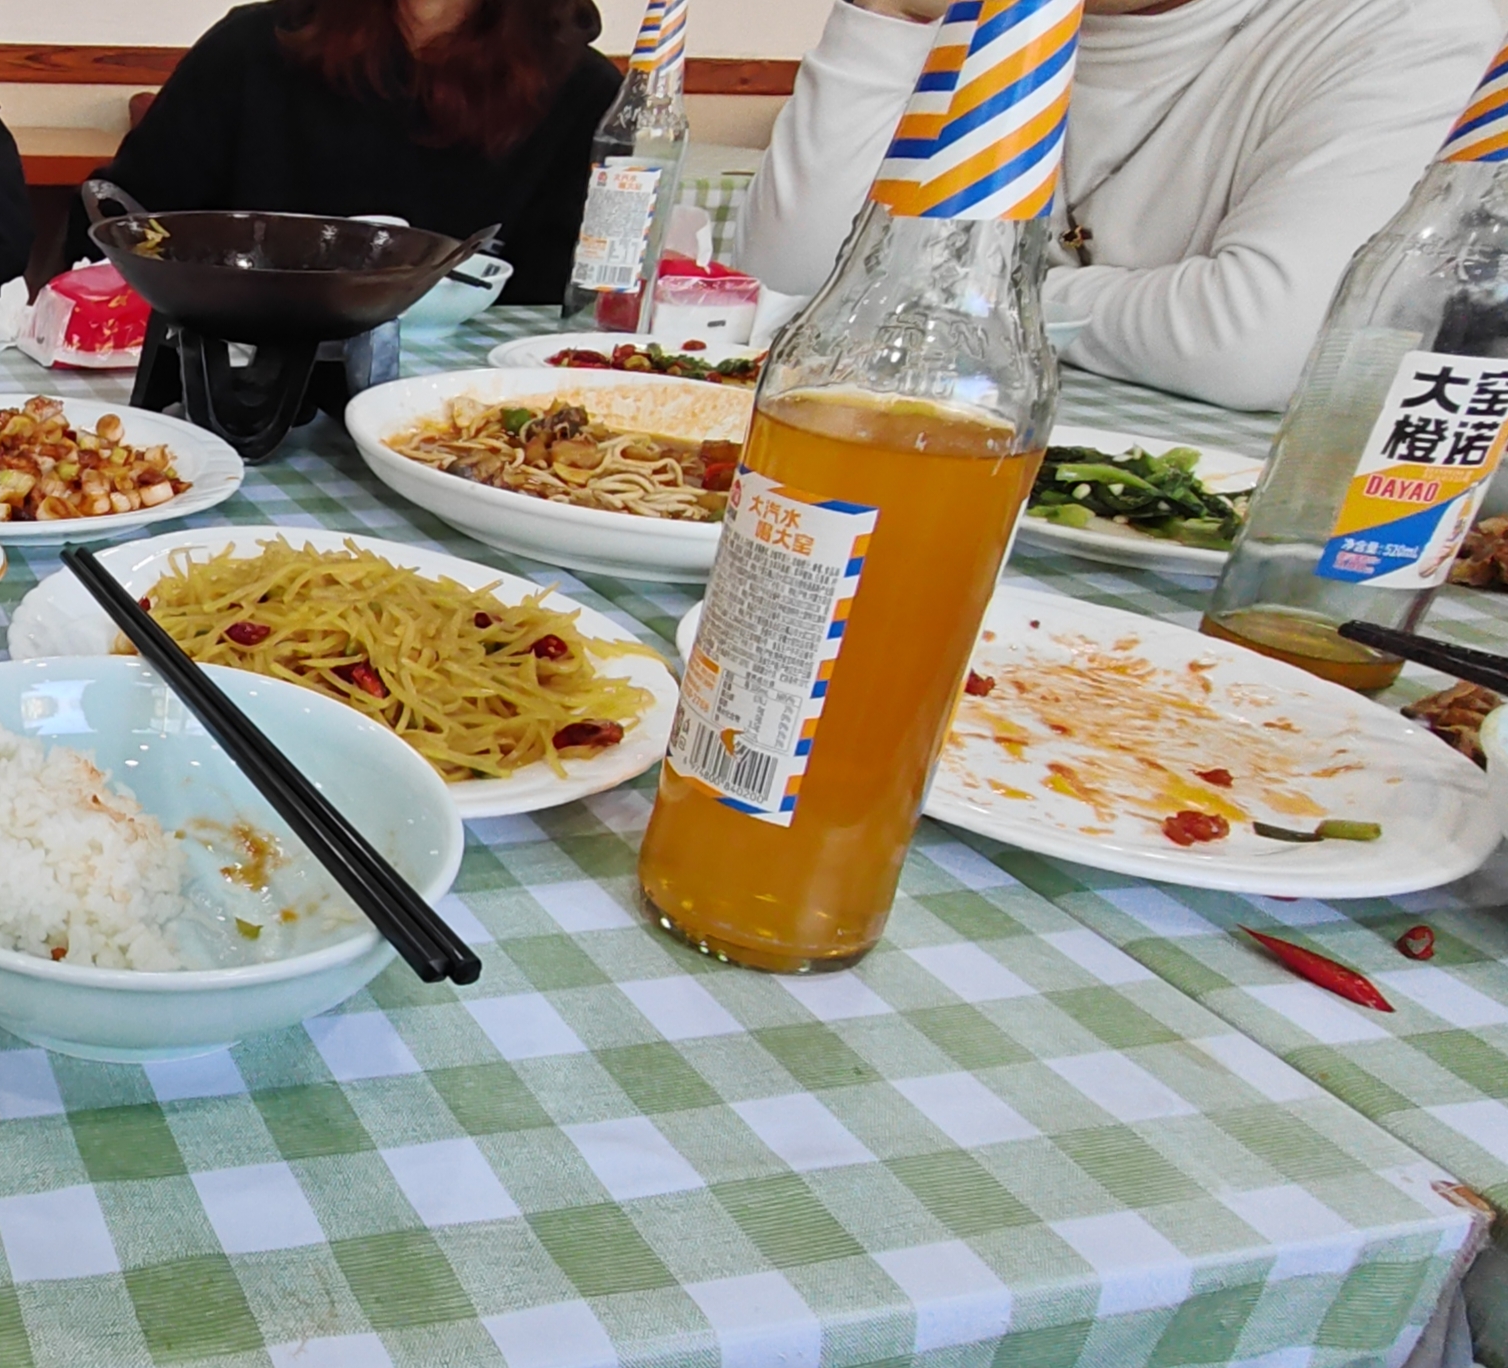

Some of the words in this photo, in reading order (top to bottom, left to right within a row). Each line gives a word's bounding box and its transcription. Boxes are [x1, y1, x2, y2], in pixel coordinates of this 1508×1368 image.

[1381, 414, 1498, 466] 橙诺
[1364, 474, 1440, 502] DAYAO
[748, 495, 801, 529] 大汽水
